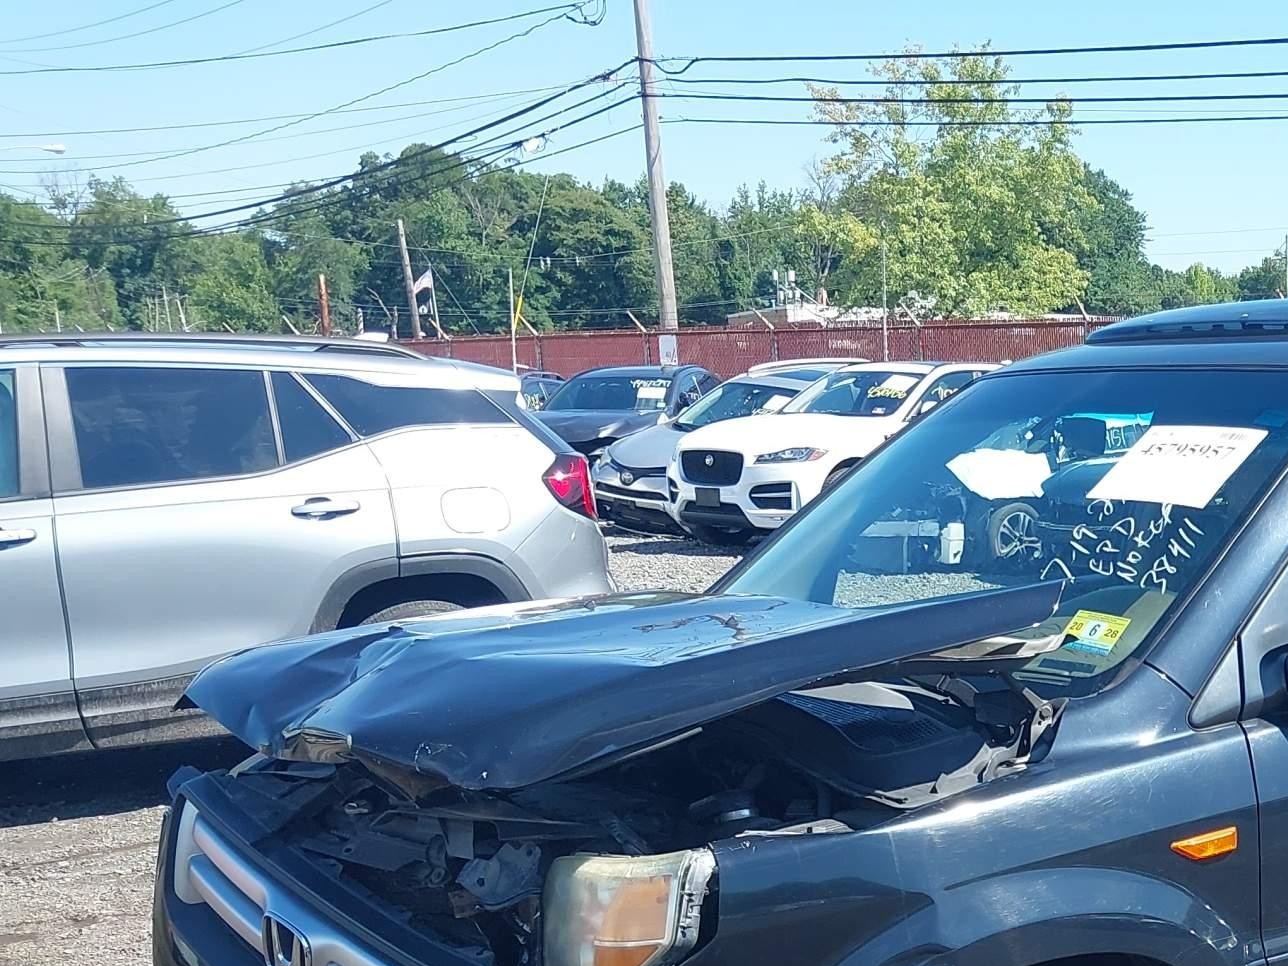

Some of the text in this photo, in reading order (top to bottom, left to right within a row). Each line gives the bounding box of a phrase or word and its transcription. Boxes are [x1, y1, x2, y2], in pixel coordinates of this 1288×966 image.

[1140, 517, 1205, 595] 38411
[1069, 621, 1084, 631] 20
[1089, 623, 1101, 637] 6
